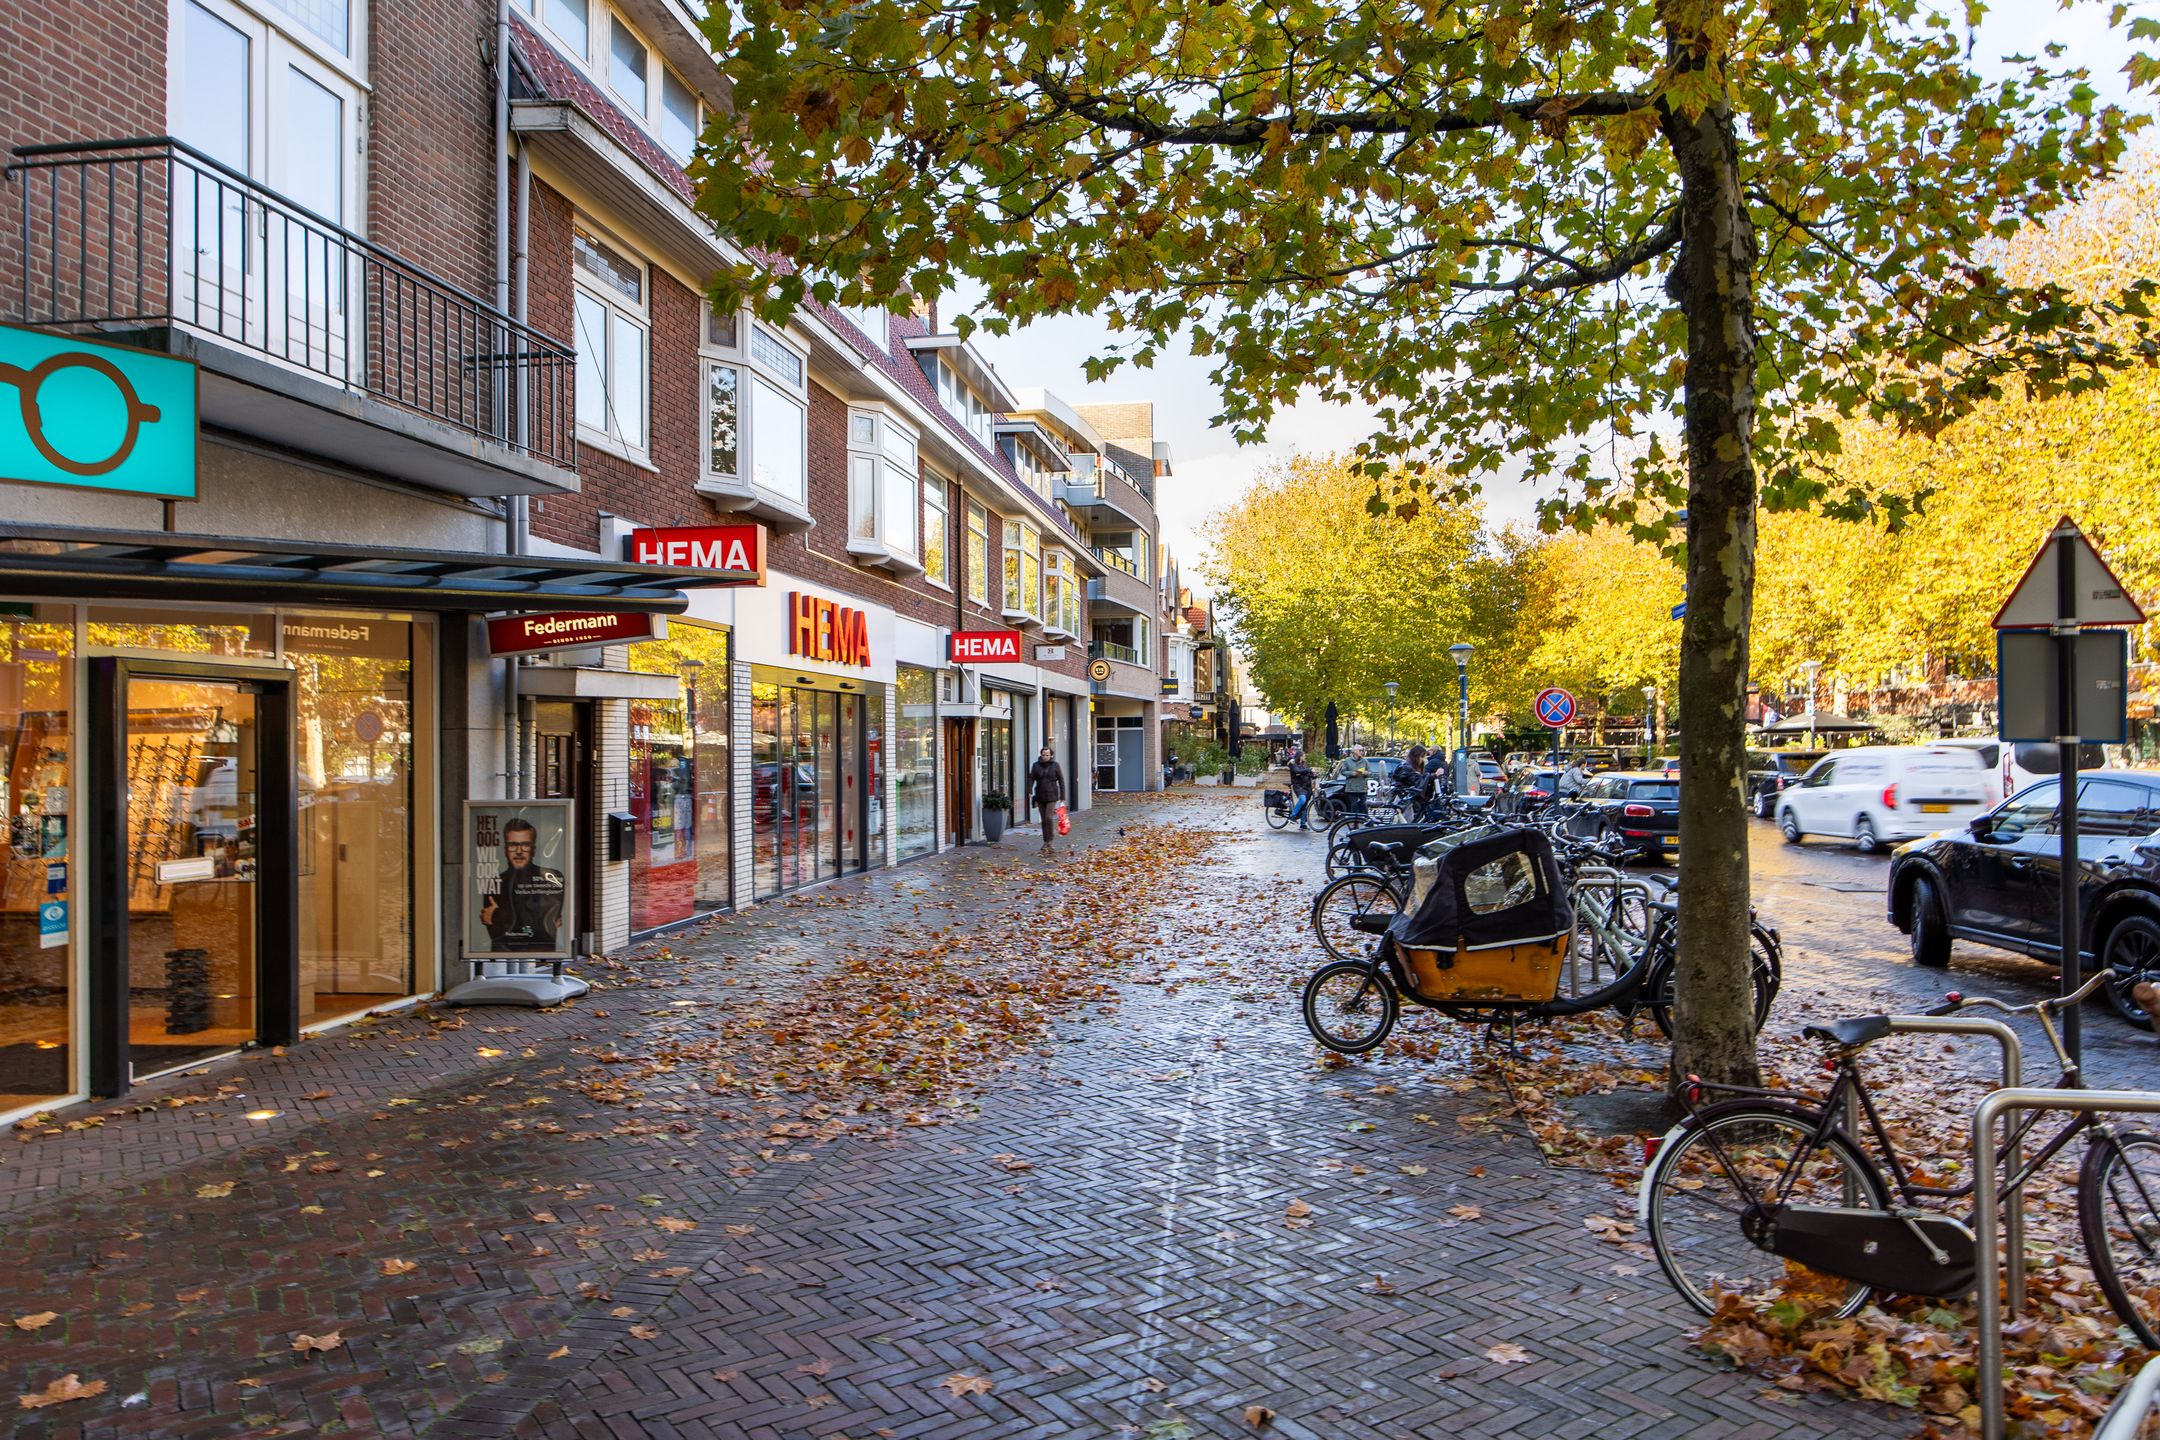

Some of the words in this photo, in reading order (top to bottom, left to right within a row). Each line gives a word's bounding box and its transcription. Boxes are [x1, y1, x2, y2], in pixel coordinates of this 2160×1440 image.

[639, 539, 750, 570] HEMA
[524, 614, 617, 636] Federmann
[789, 591, 871, 667] HEMA
[955, 638, 1016, 656] HEMA
[476, 815, 498, 831] HET
[476, 831, 500, 847] OOG
[476, 847, 499, 863] WIL
[476, 863, 500, 879] OOK
[476, 879, 503, 895] WAT
